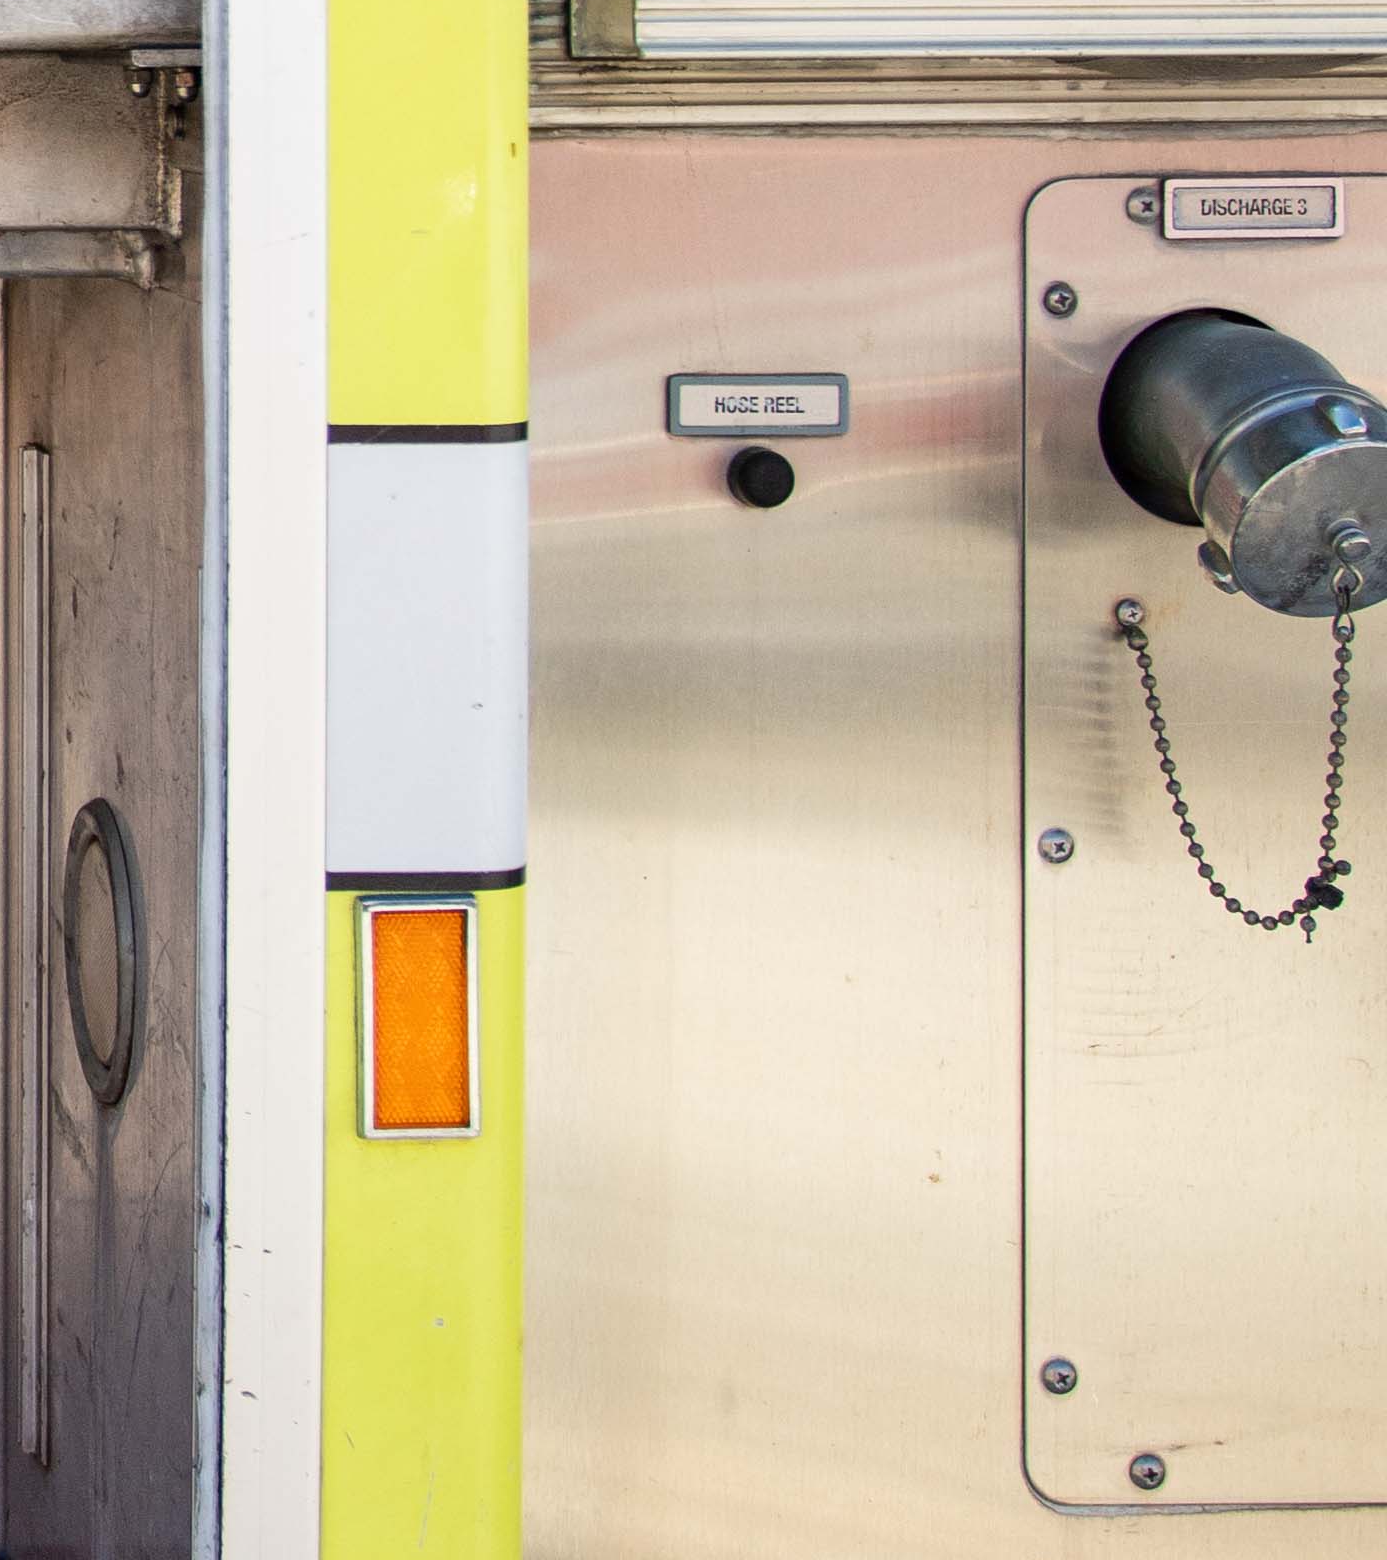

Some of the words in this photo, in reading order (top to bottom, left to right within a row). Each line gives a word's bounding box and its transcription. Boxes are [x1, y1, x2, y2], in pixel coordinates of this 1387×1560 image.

[1201, 198, 1293, 216] DISCHARGE
[1297, 198, 1308, 215] 3
[714, 396, 759, 413] HOSE
[764, 396, 805, 413] REEL
